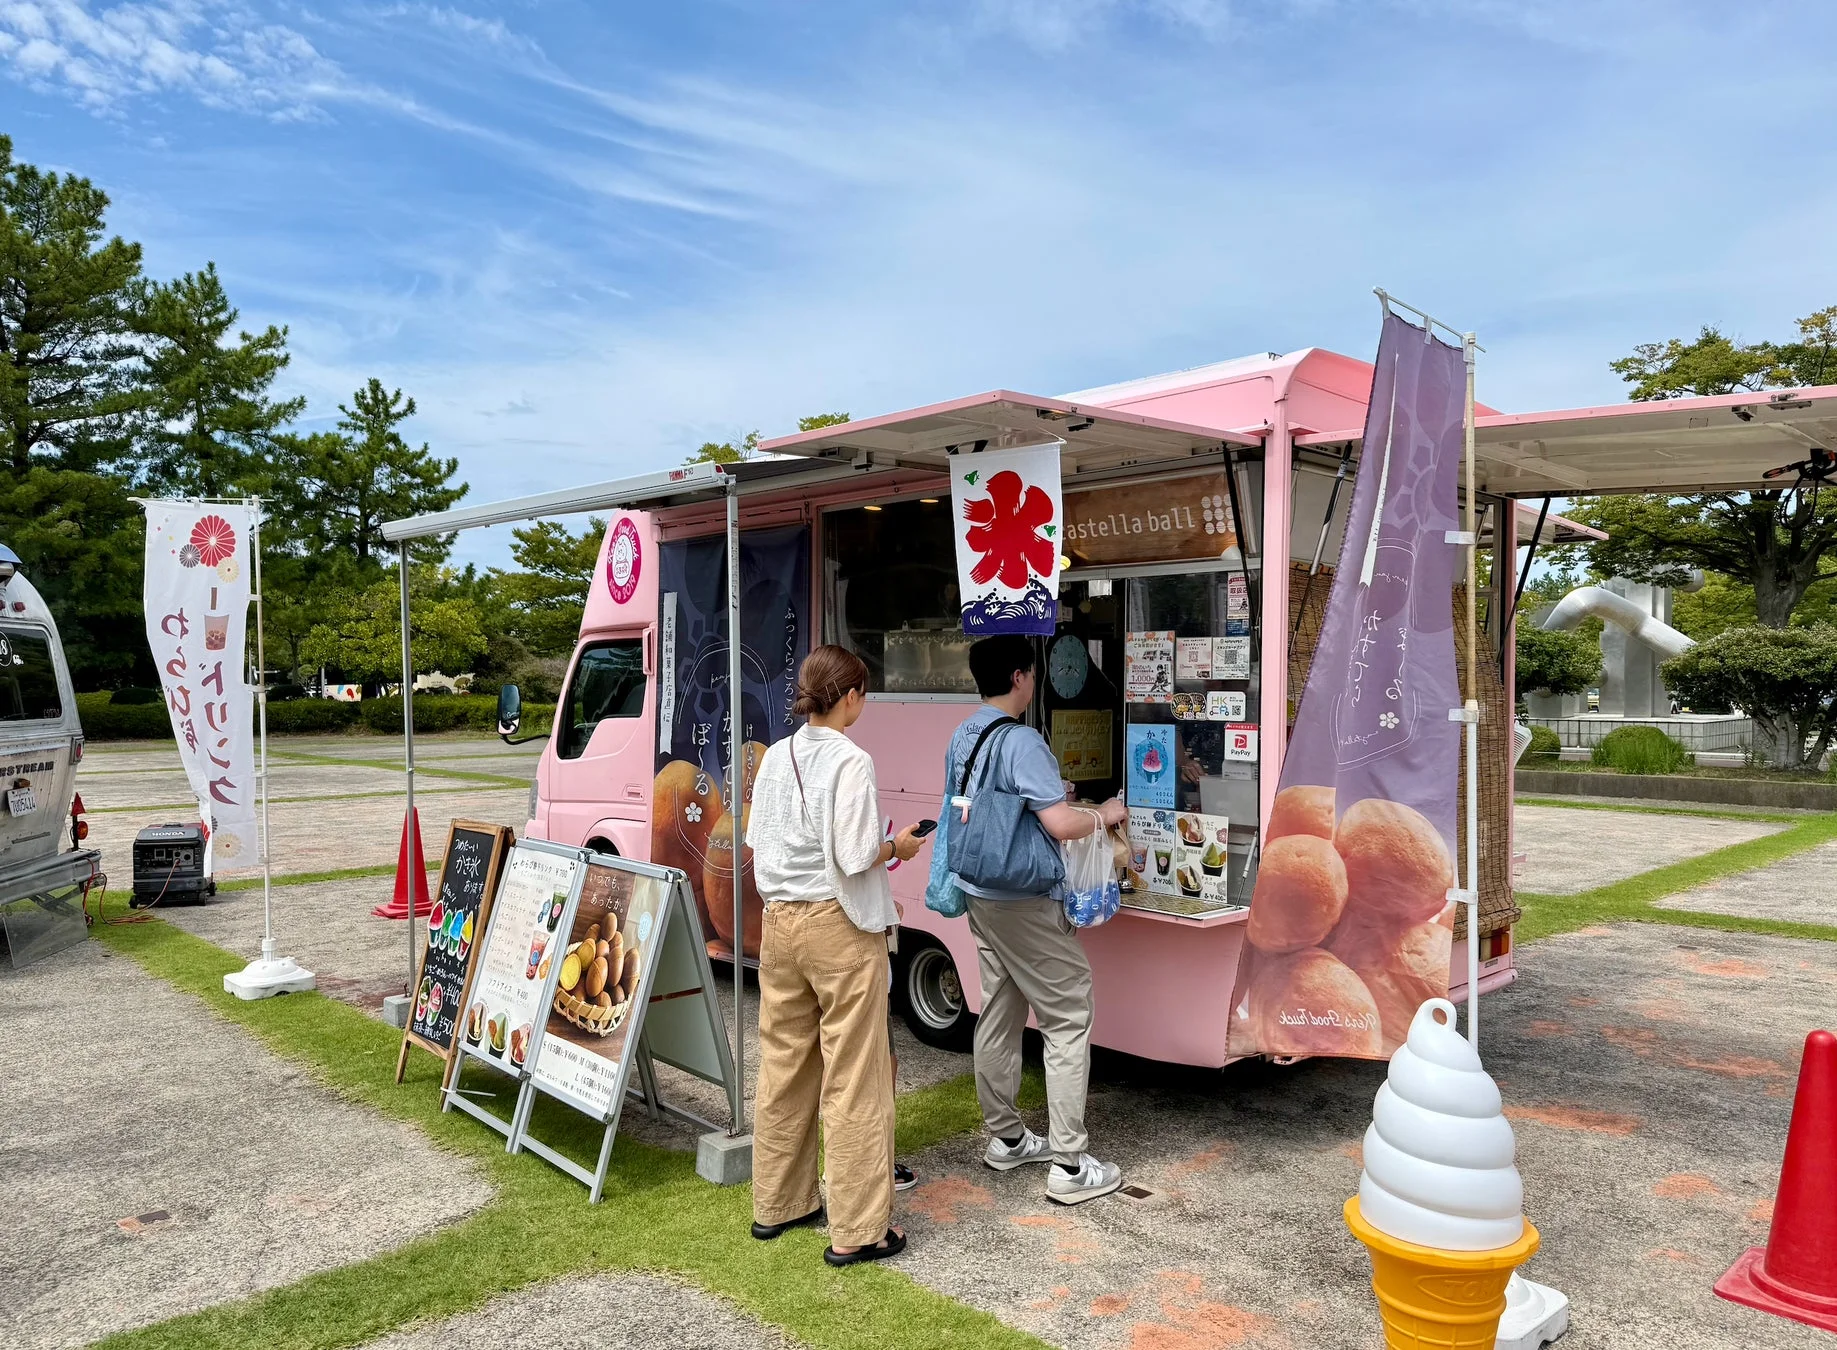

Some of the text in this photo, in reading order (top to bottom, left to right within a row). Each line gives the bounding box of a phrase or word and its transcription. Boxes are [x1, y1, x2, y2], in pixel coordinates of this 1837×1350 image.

[1147, 506, 1196, 533] ball
[1230, 749, 1251, 757] PayPay
[151, 829, 185, 839] HONDA
[456, 855, 481, 878] かき氷
